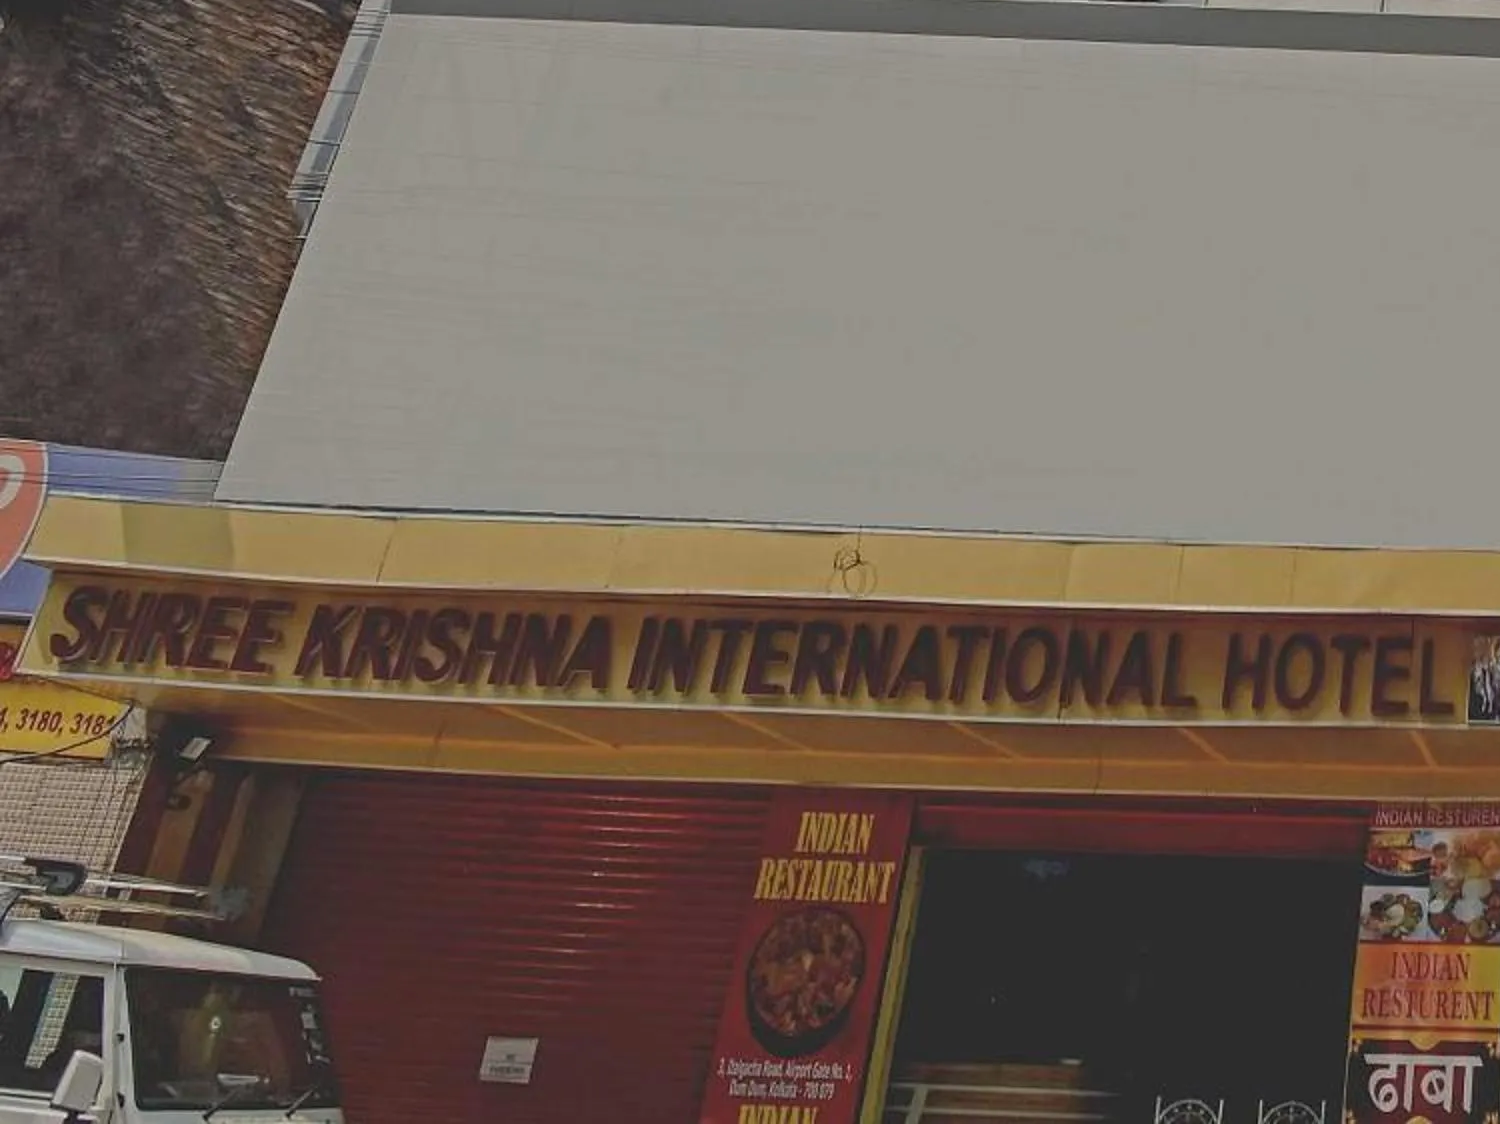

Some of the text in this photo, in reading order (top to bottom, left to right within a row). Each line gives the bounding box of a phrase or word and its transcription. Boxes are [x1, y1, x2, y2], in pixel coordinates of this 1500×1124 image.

[51, 586, 296, 673] SHREE
[294, 604, 612, 689] KRISHNA
[626, 616, 1197, 707] INTERNATIONAL
[1221, 632, 1455, 716] HOTEL
[15, 707, 64, 737] 3180,
[794, 811, 875, 854] INDIAN
[1375, 808, 1423, 826] INDIAN
[753, 857, 896, 904] RESTAURANT
[1390, 951, 1472, 981] INDIAN
[1361, 987, 1495, 1021] RESTURENT
[1363, 1053, 1484, 1114] ढाबा
